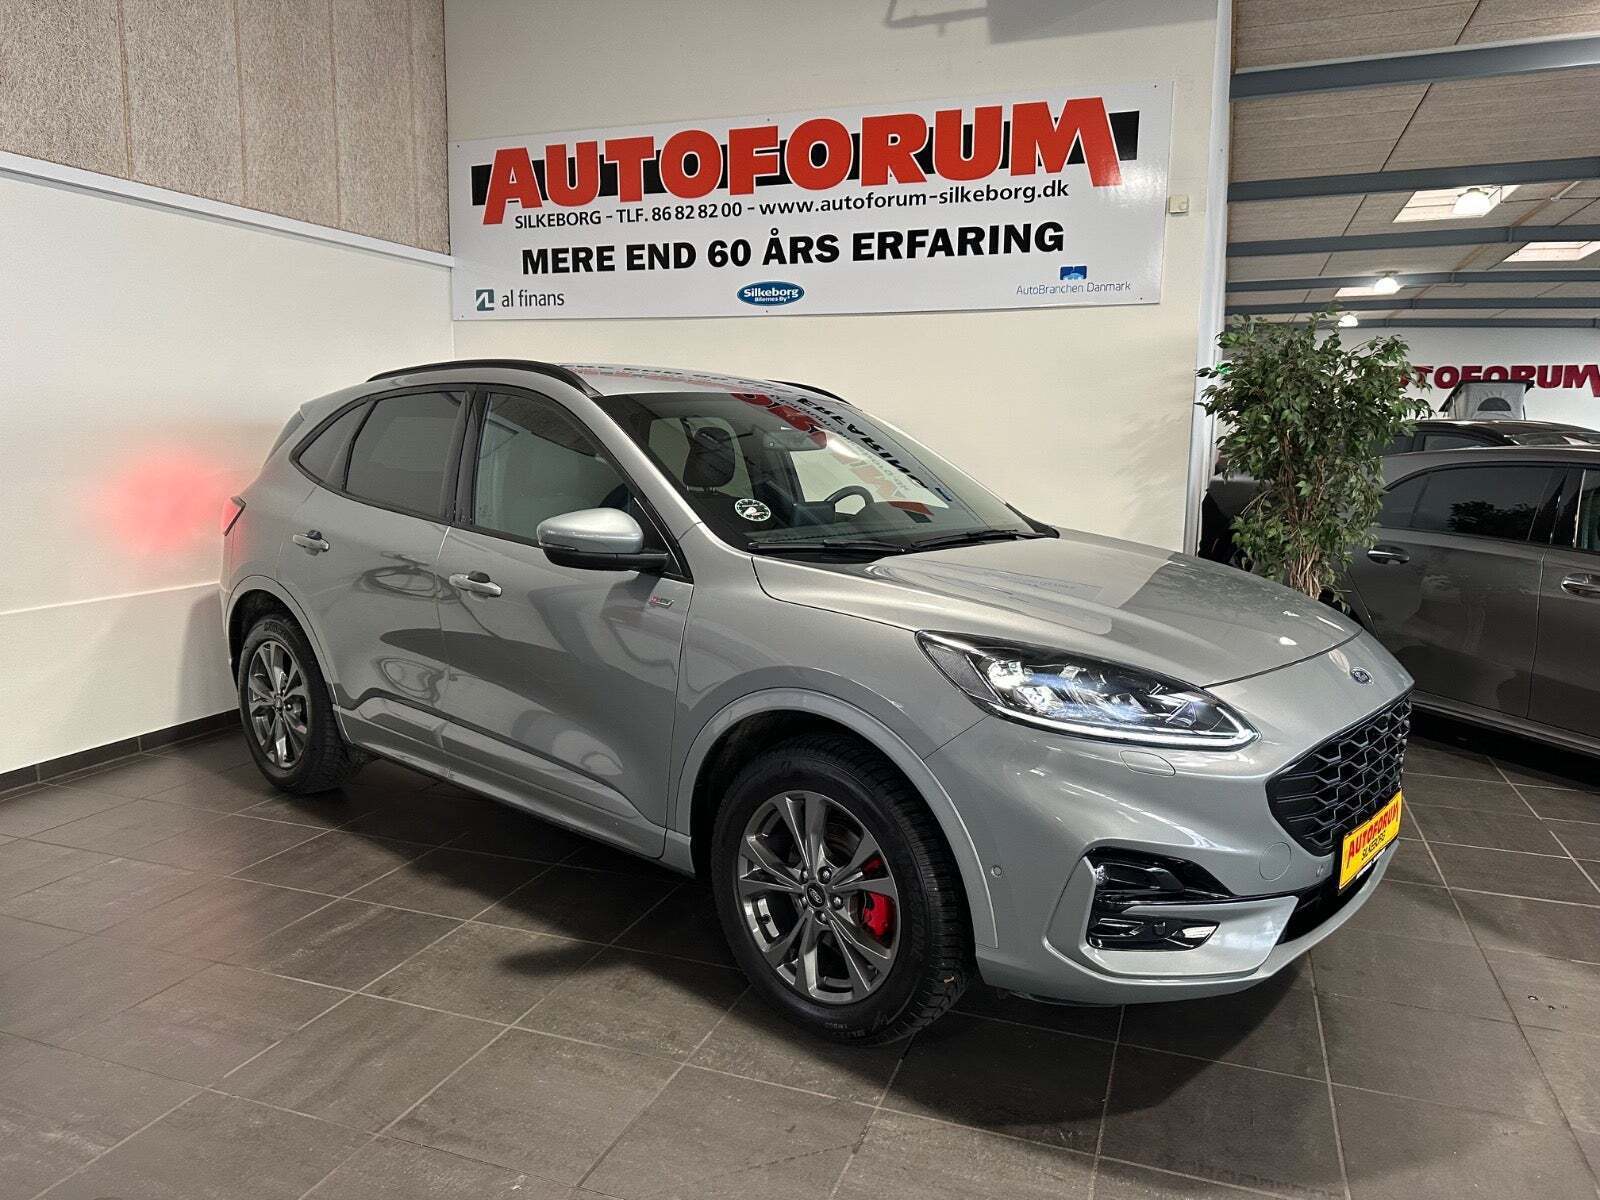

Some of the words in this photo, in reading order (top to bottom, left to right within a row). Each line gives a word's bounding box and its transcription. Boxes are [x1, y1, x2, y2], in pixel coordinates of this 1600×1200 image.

[482, 97, 1122, 224] AUTOFORUM
[515, 209, 602, 229] SILKEBORG
[616, 207, 649, 224] TLF.
[759, 180, 1069, 215] www.autoforum-silkeborg.dk
[522, 246, 616, 275] MERE
[626, 242, 697, 271] END
[707, 238, 752, 268] 60
[762, 228, 840, 266] ÅRS
[852, 221, 1064, 262] ERFARING
[501, 290, 514, 308] al
[518, 289, 565, 307] finans
[743, 287, 799, 298] Silkeborg
[1016, 283, 1084, 295] AutoBranchen
[1086, 281, 1131, 293] Danmark
[1347, 799, 1399, 868] AUTOFORUM
